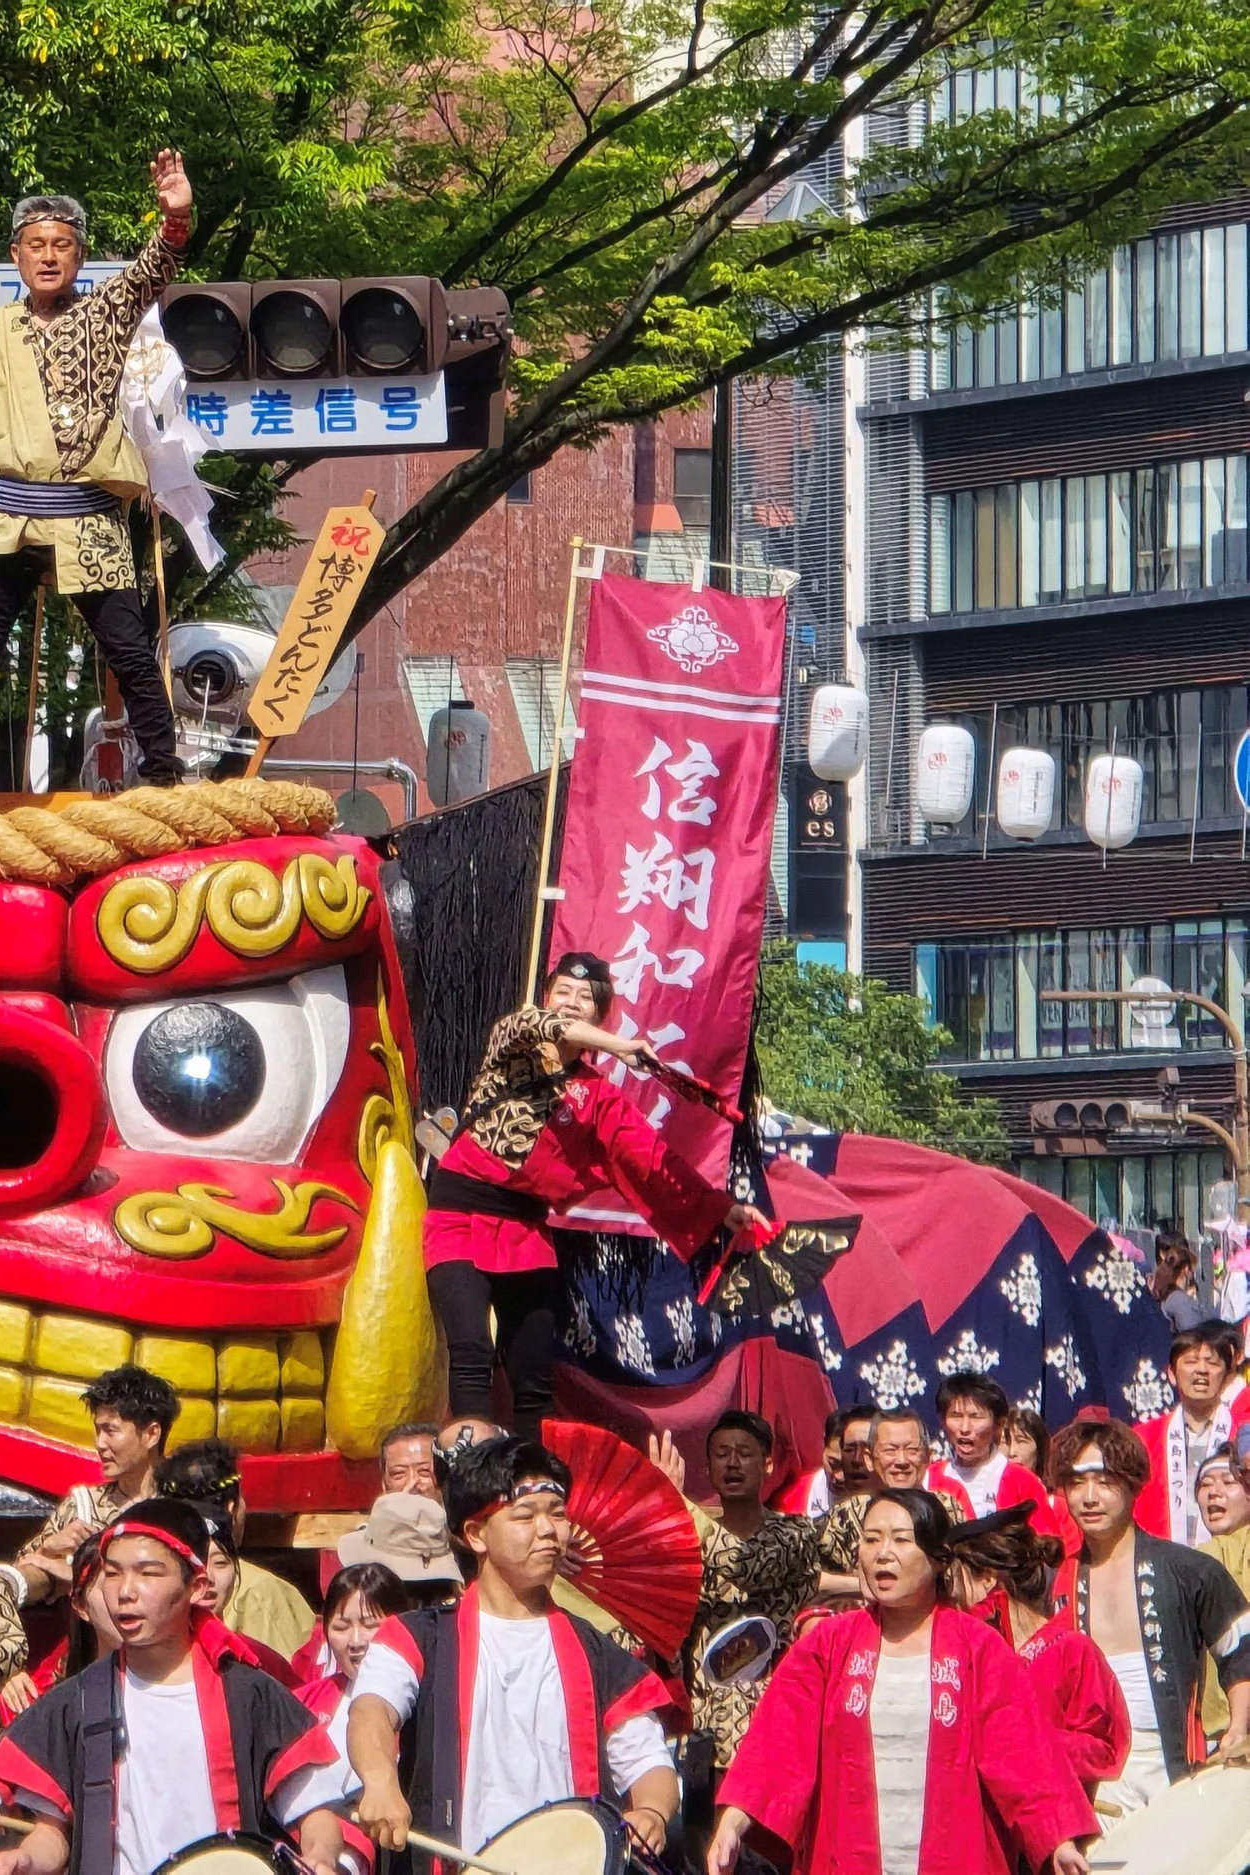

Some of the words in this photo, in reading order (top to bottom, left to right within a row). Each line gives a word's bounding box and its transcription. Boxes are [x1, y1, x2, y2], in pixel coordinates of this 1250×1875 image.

[186, 387, 422, 436] 時差信号
[806, 821, 835, 837] es
[931, 1657, 961, 1727] 城島
